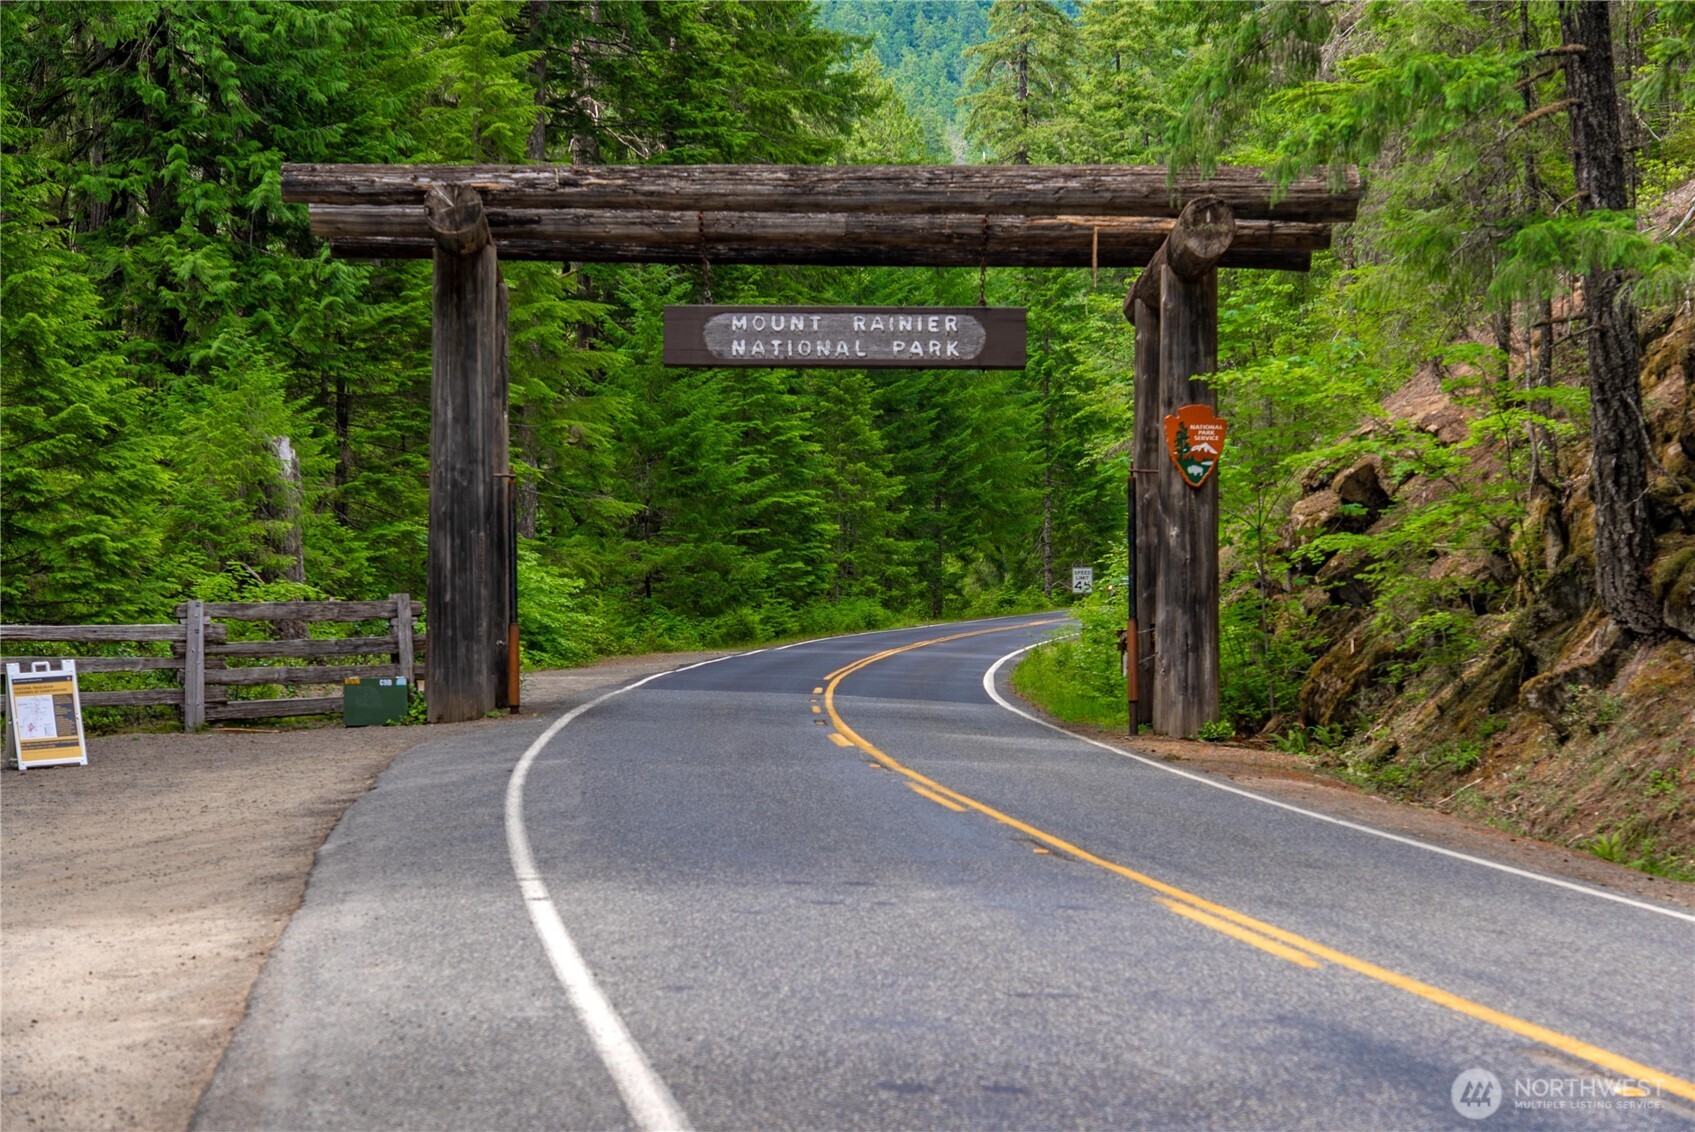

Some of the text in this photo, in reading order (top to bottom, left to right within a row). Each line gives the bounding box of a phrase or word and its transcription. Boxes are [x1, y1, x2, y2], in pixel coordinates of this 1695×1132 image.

[731, 315, 959, 333] MOUNT RAINIER
[731, 340, 960, 358] NATIONAL PARK
